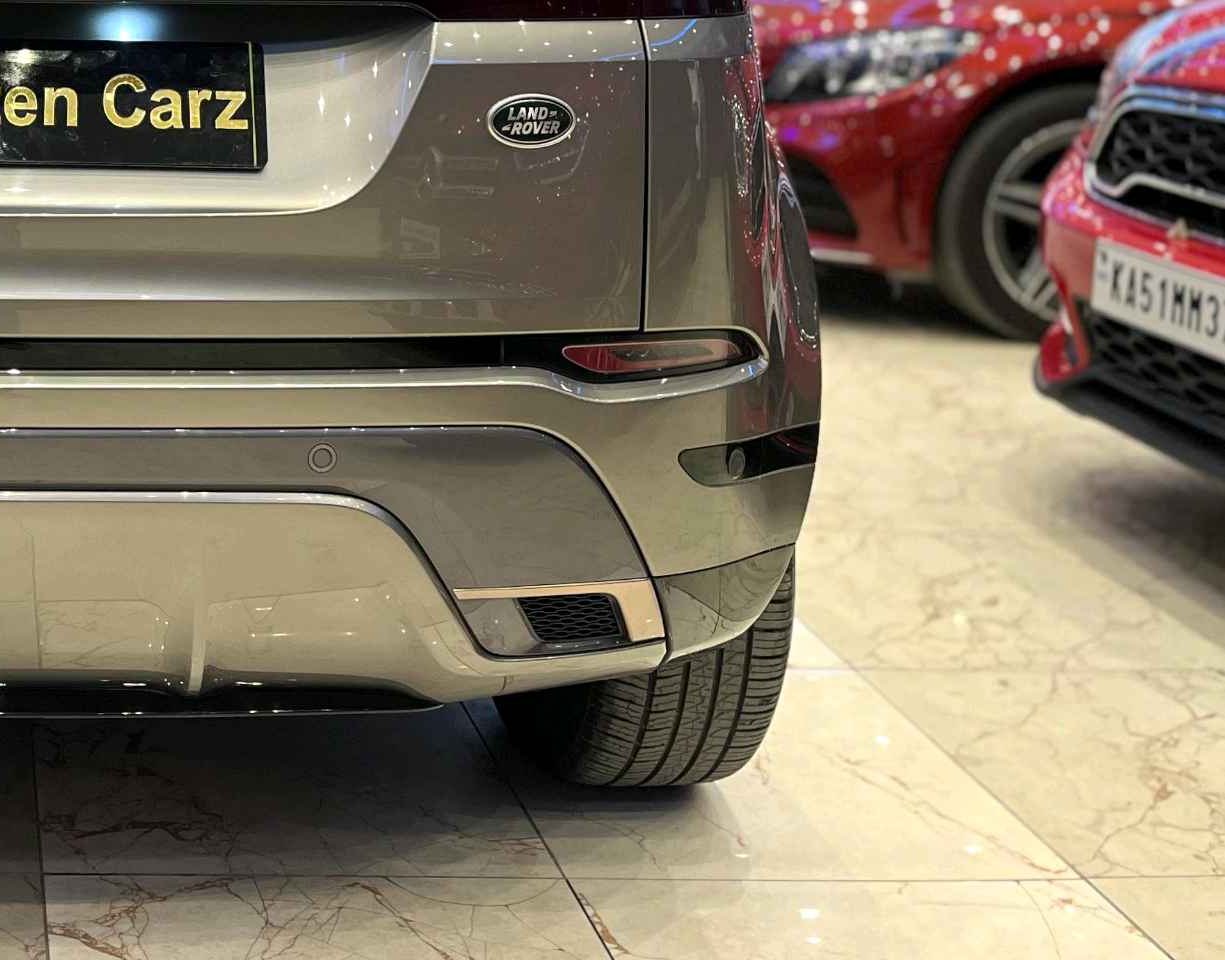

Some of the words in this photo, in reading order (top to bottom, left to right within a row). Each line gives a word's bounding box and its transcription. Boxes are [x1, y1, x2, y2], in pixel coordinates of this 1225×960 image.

[102, 74, 250, 130] Carz
[508, 106, 549, 121] LAND
[510, 121, 561, 135] ROVER
[1110, 260, 1225, 343] KA51MM3
